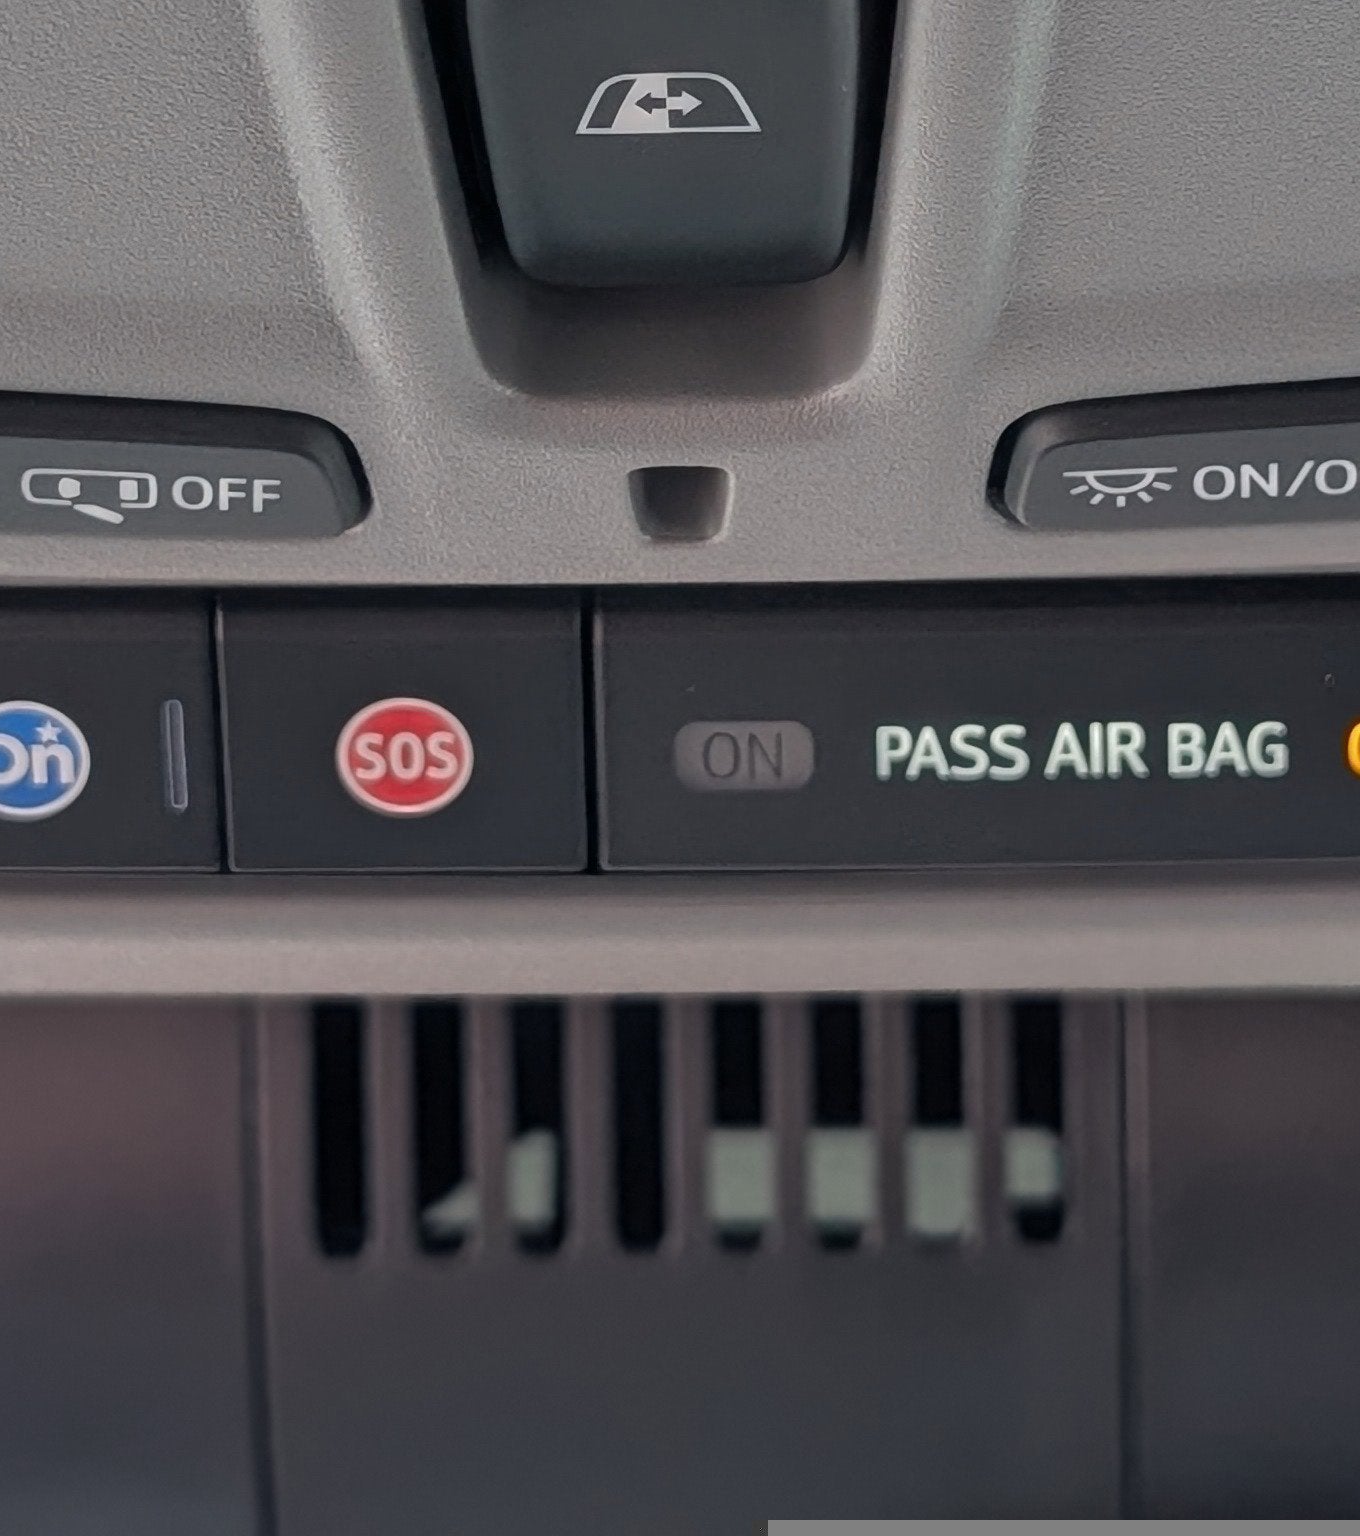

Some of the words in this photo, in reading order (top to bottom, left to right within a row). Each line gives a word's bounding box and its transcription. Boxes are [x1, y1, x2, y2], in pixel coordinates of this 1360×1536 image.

[170, 474, 281, 517] OFF
[355, 731, 458, 781] SOS
[703, 733, 785, 781] ON
[876, 725, 1029, 779] PASS
[1045, 723, 1150, 778] AIR
[1167, 722, 1289, 776] BAG
